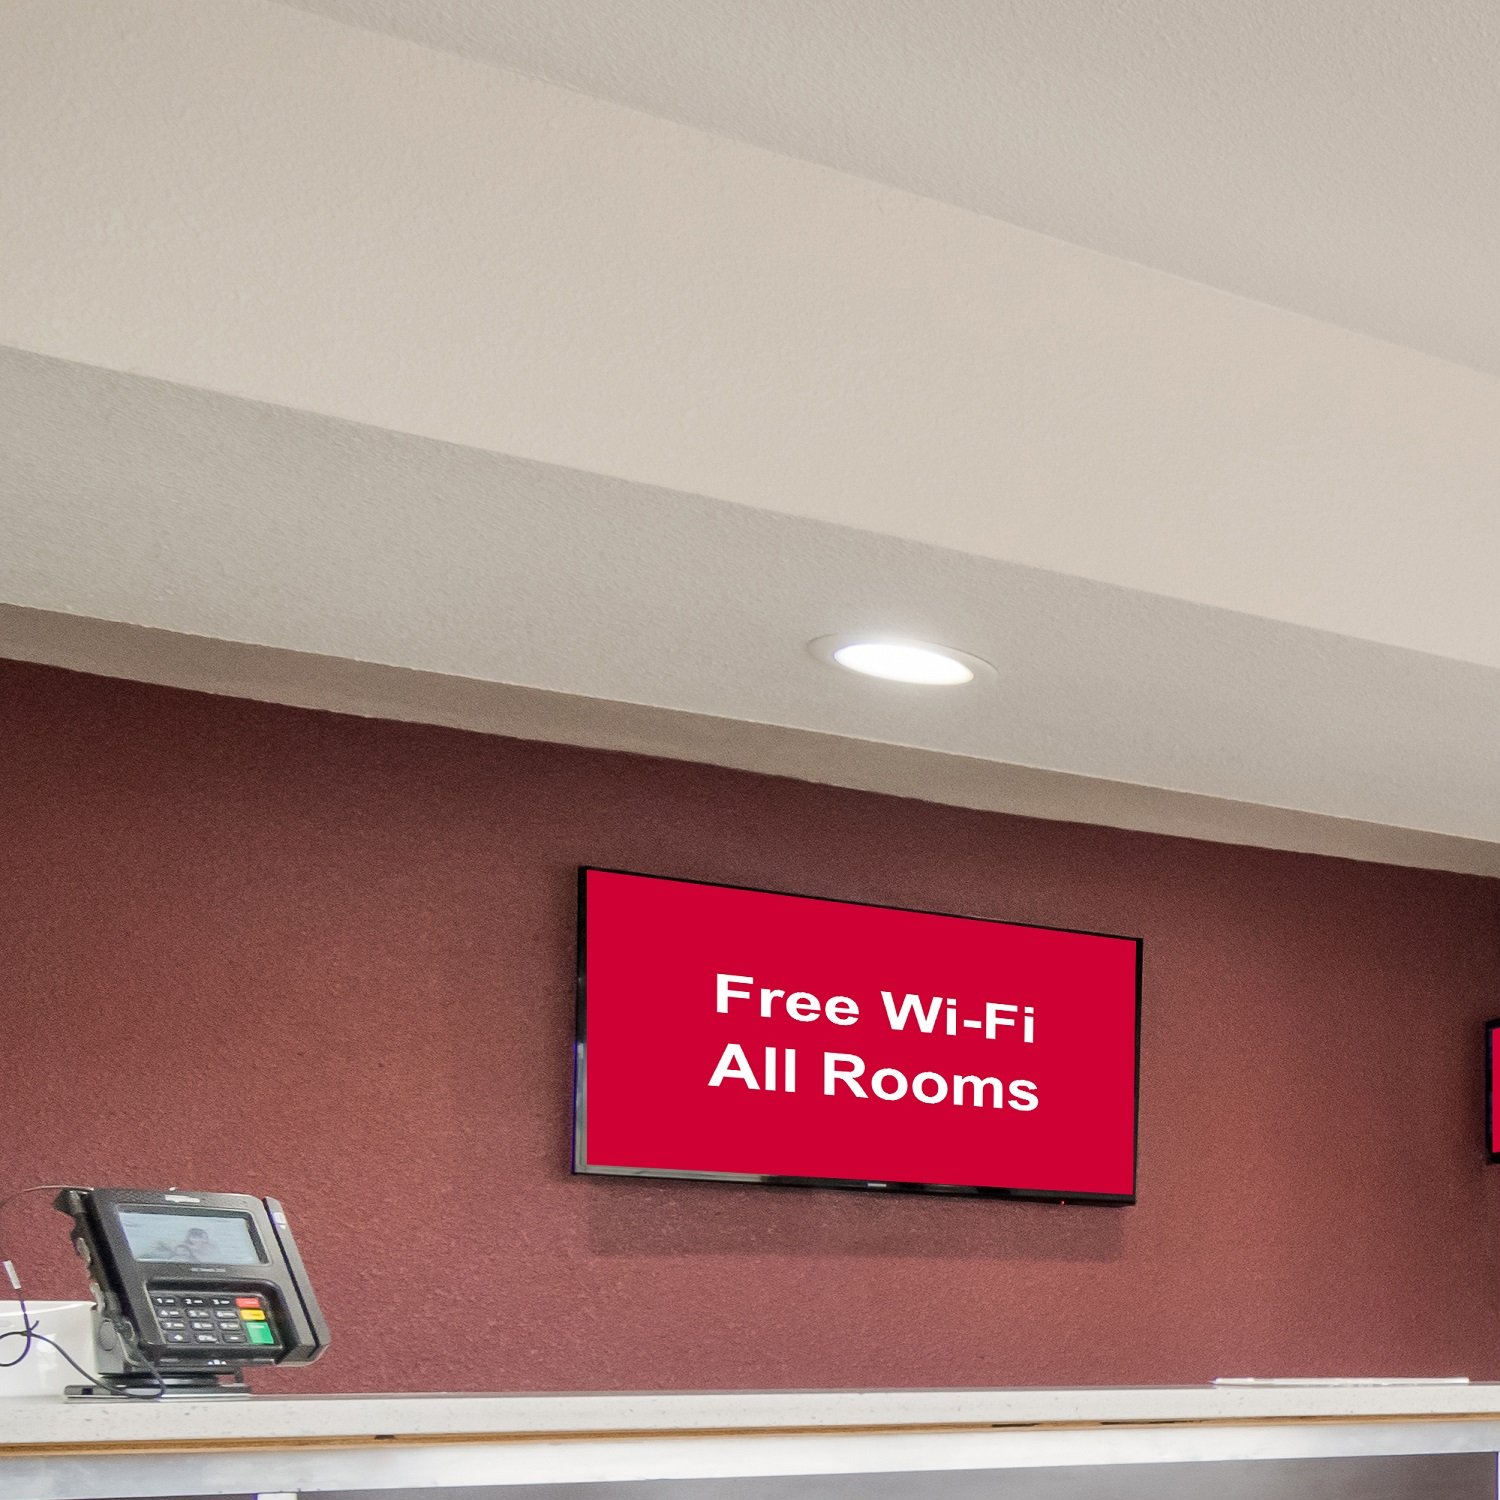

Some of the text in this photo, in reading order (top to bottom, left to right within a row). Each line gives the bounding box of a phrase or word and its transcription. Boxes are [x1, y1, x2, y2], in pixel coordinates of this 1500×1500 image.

[716, 973, 1035, 1044] Free Wi-Fi
[707, 1043, 1039, 1112] All Rooms
